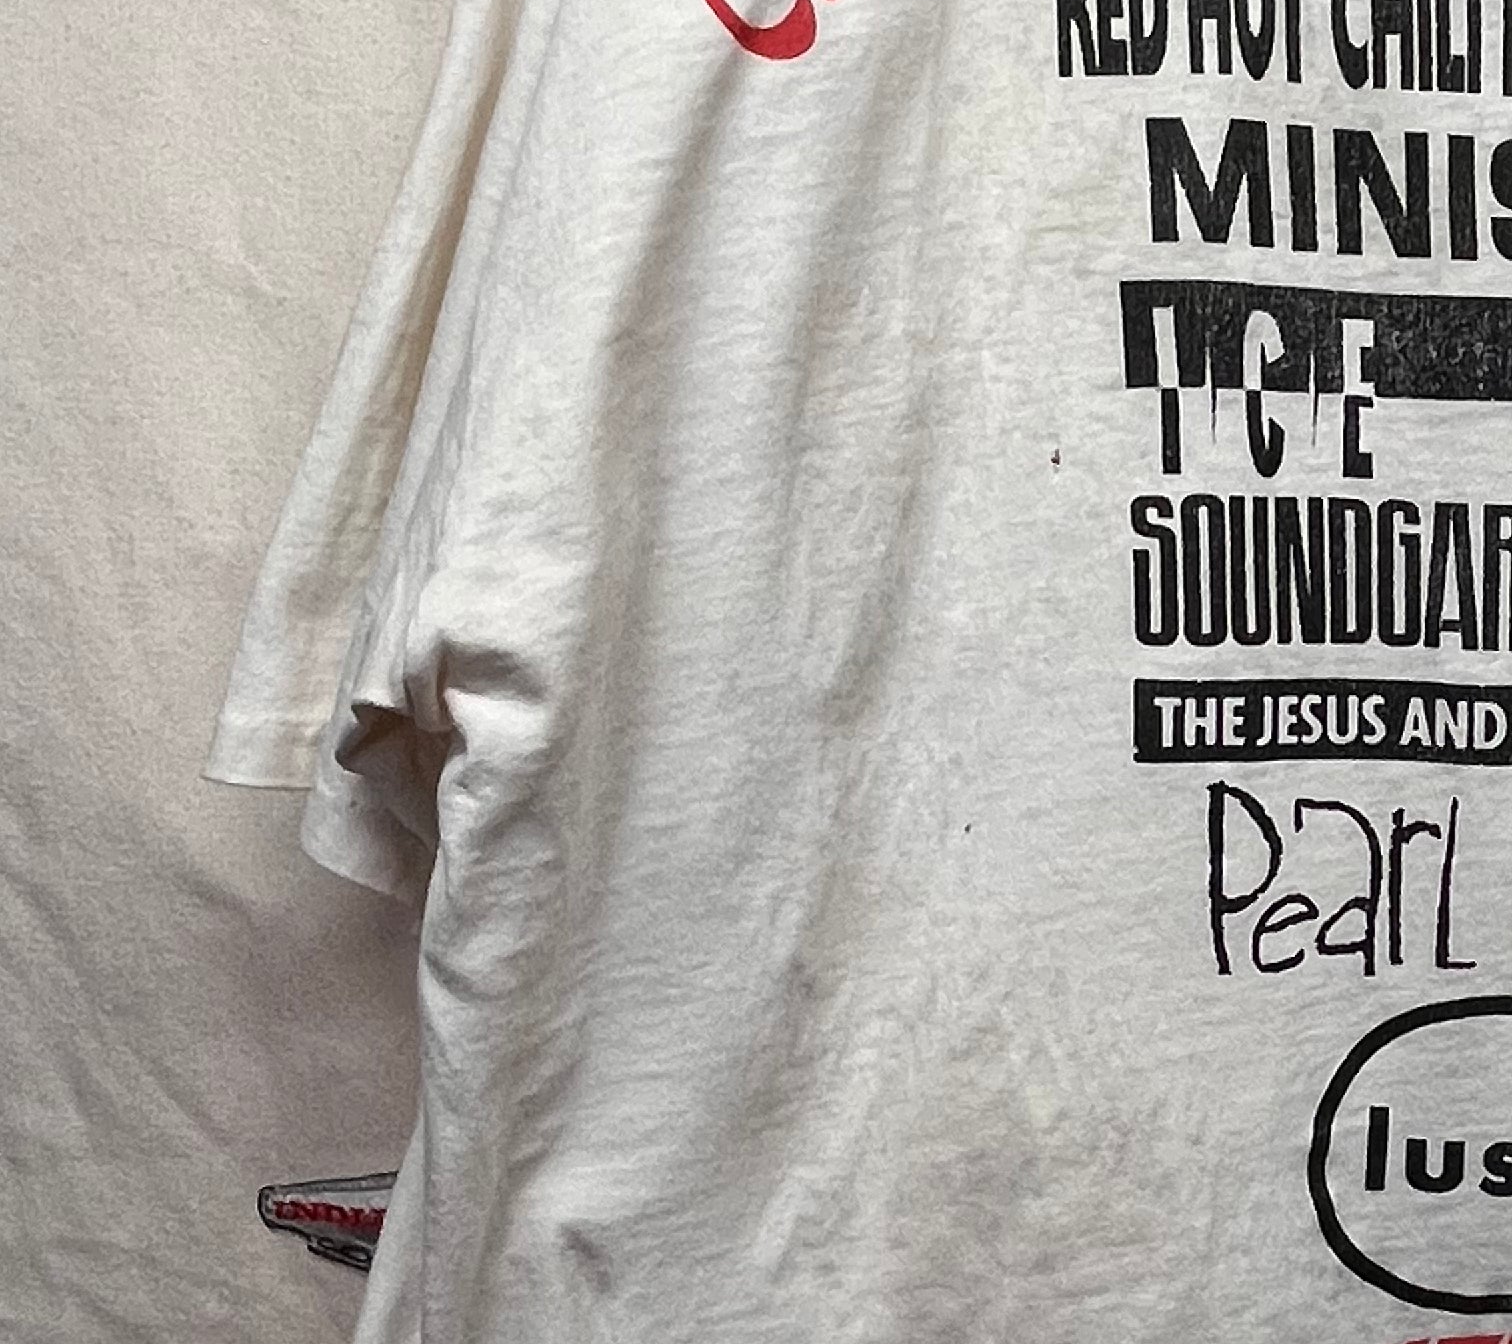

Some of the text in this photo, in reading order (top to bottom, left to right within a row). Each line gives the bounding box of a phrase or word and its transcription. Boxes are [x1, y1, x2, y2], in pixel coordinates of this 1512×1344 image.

[1151, 305, 1376, 479] ICE
[1154, 694, 1247, 750] THE
[1255, 693, 1386, 750] JESUS
[1400, 697, 1508, 752] AND
